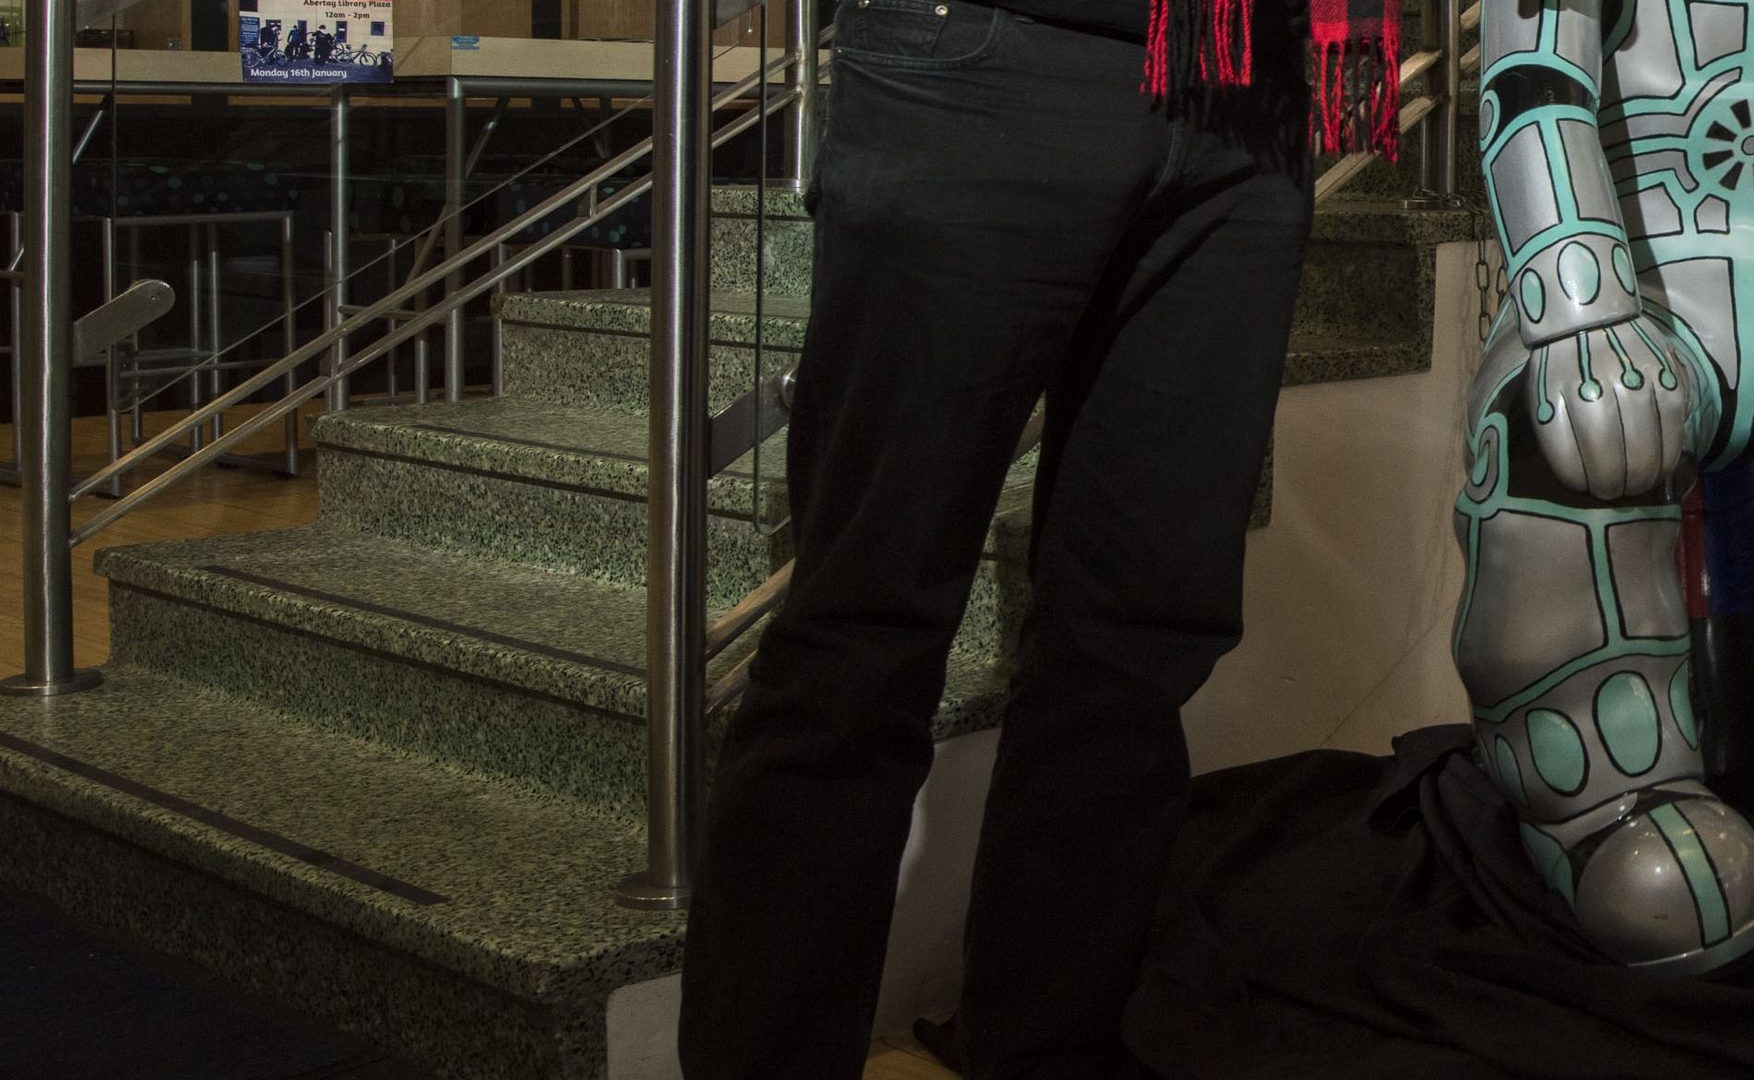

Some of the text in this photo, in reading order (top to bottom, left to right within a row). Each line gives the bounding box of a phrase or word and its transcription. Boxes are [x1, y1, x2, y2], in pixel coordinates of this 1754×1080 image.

[303, 0, 336, 8] Abertay
[338, 0, 367, 9] Library
[325, 11, 346, 19] 12am
[353, 12, 370, 20] 2pm
[250, 69, 348, 79] Monday 16th January
